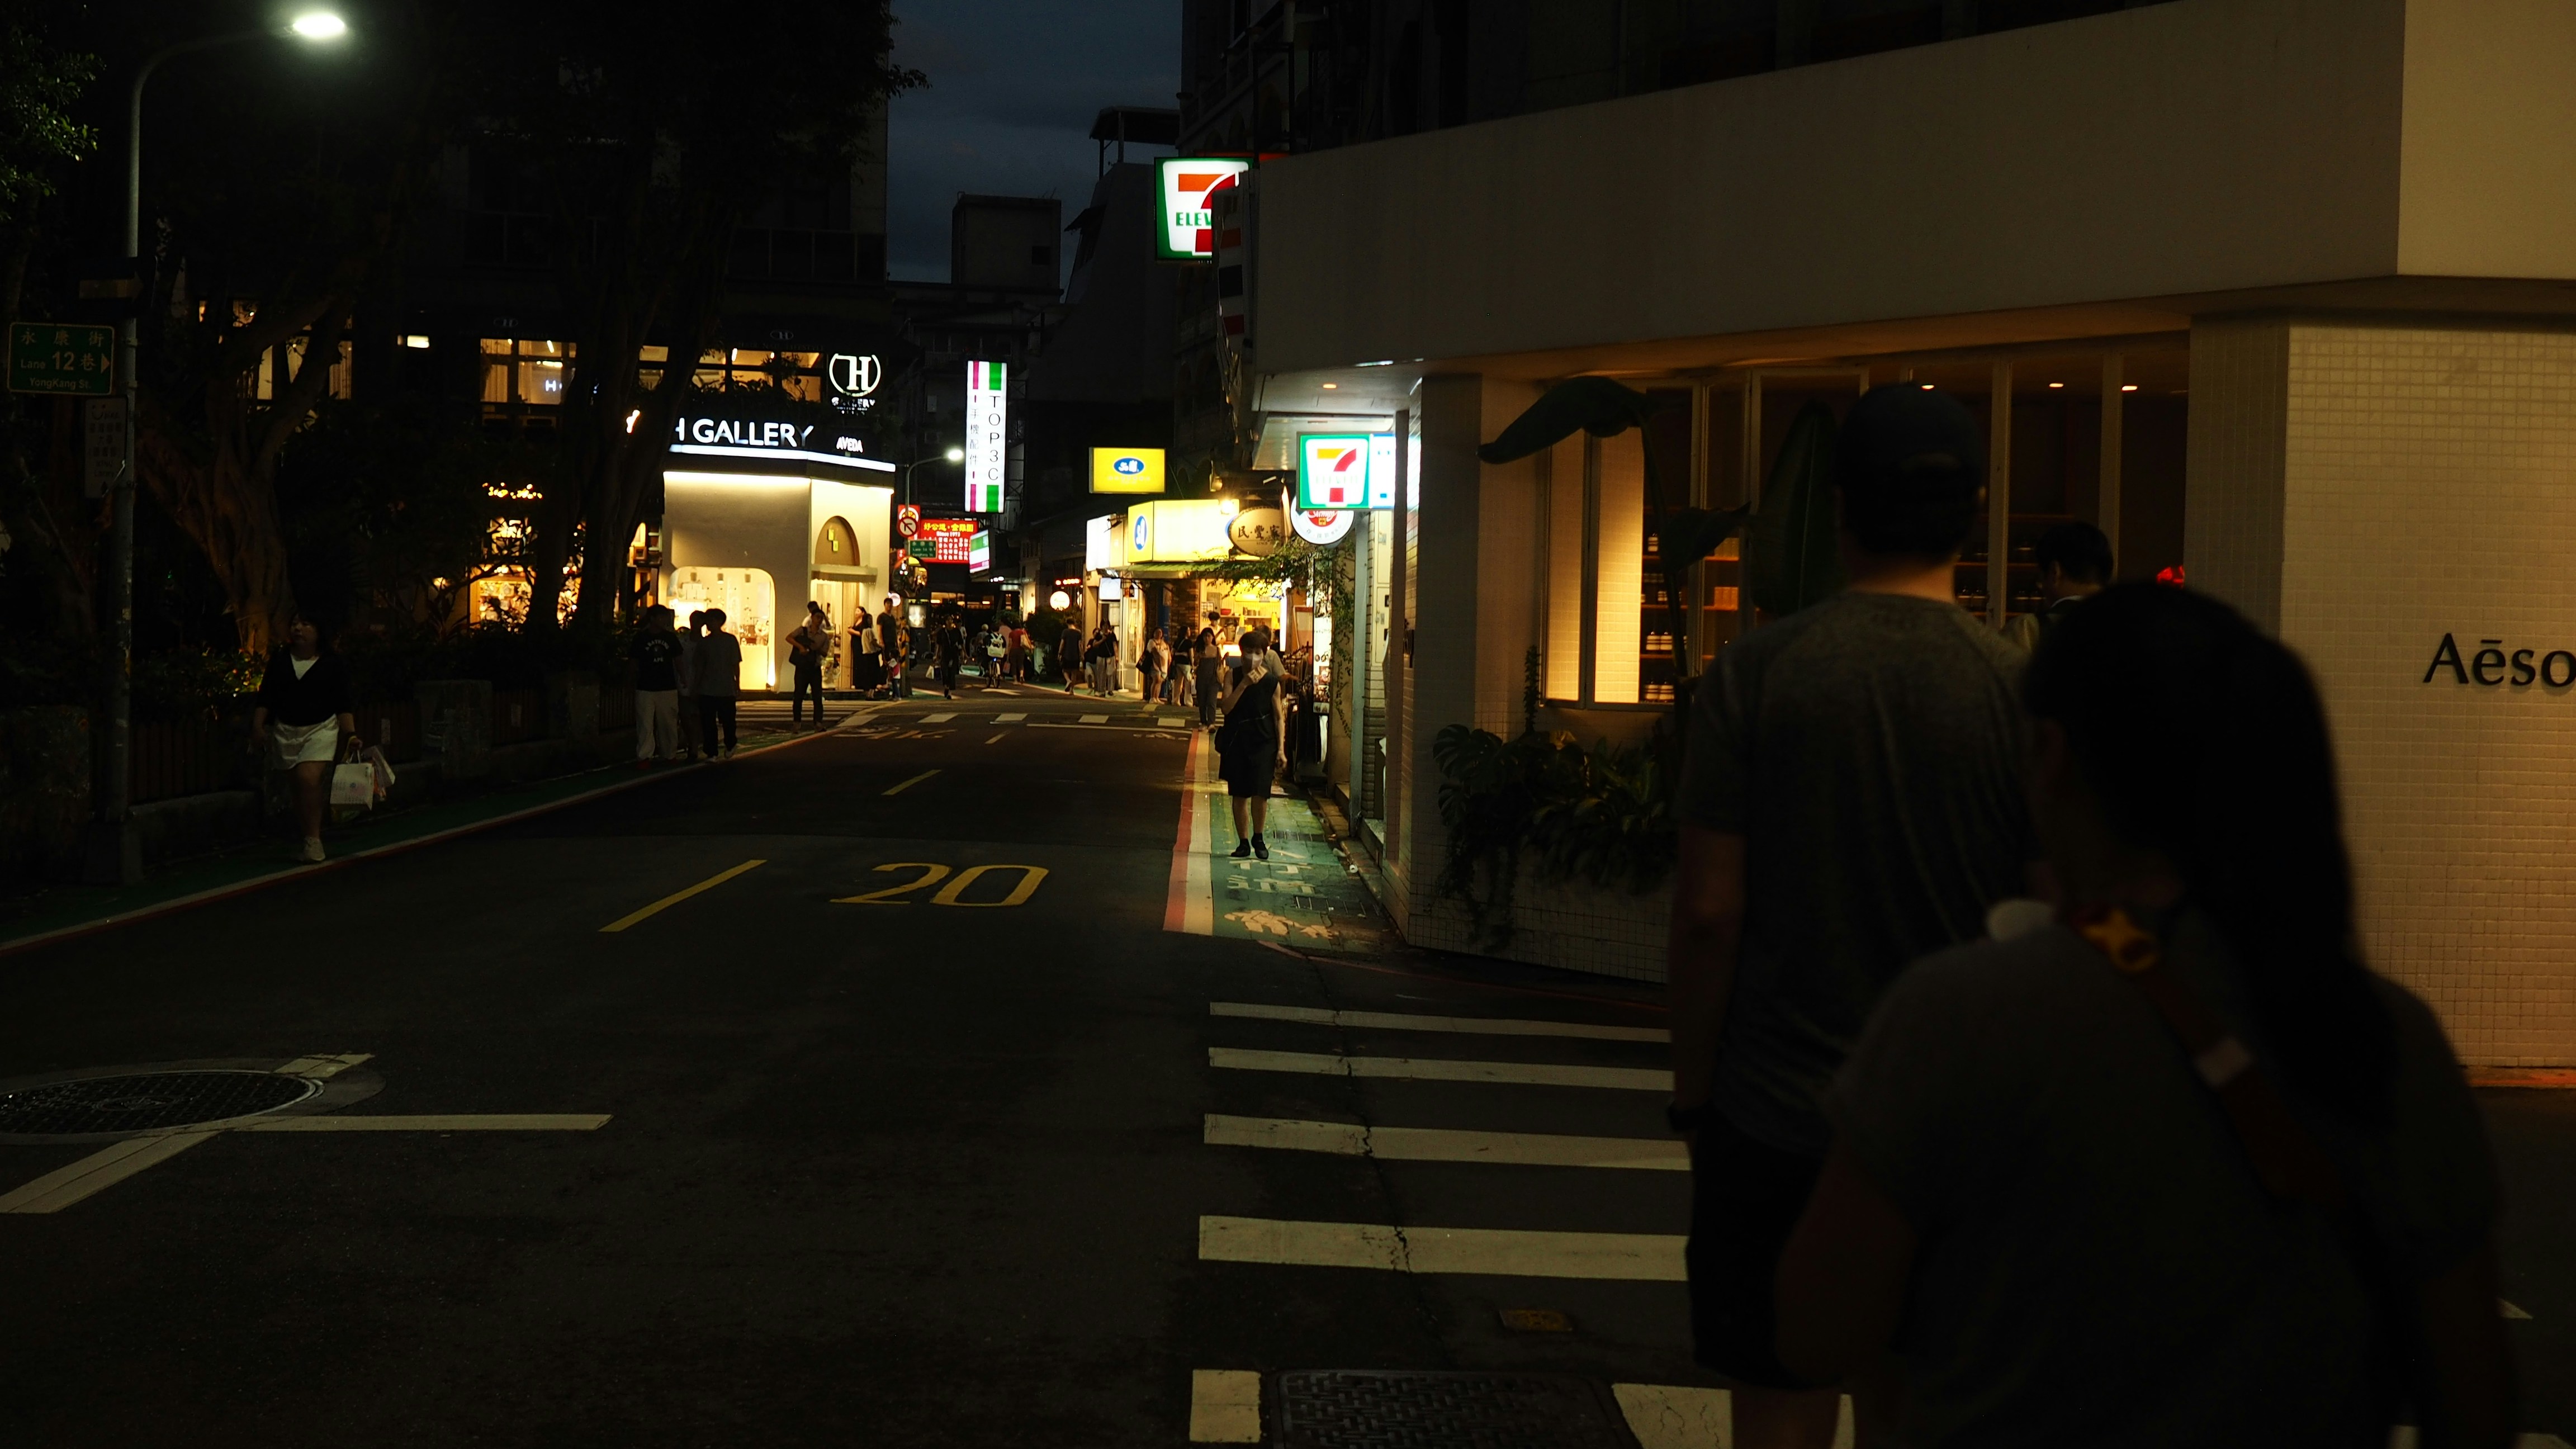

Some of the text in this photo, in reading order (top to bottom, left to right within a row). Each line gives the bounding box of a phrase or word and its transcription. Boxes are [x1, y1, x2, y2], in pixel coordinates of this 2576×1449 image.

[1176, 212, 1212, 226] ELEV
[21, 328, 105, 347] 永康街
[21, 351, 96, 371] Lane 12 巷
[30, 377, 76, 390] YongKang
[693, 419, 813, 447] GALLERY
[969, 409, 979, 466] 手機配件
[836, 437, 863, 453] AVEDA
[1317, 448, 1357, 502] 7
[829, 861, 1049, 907] 20
